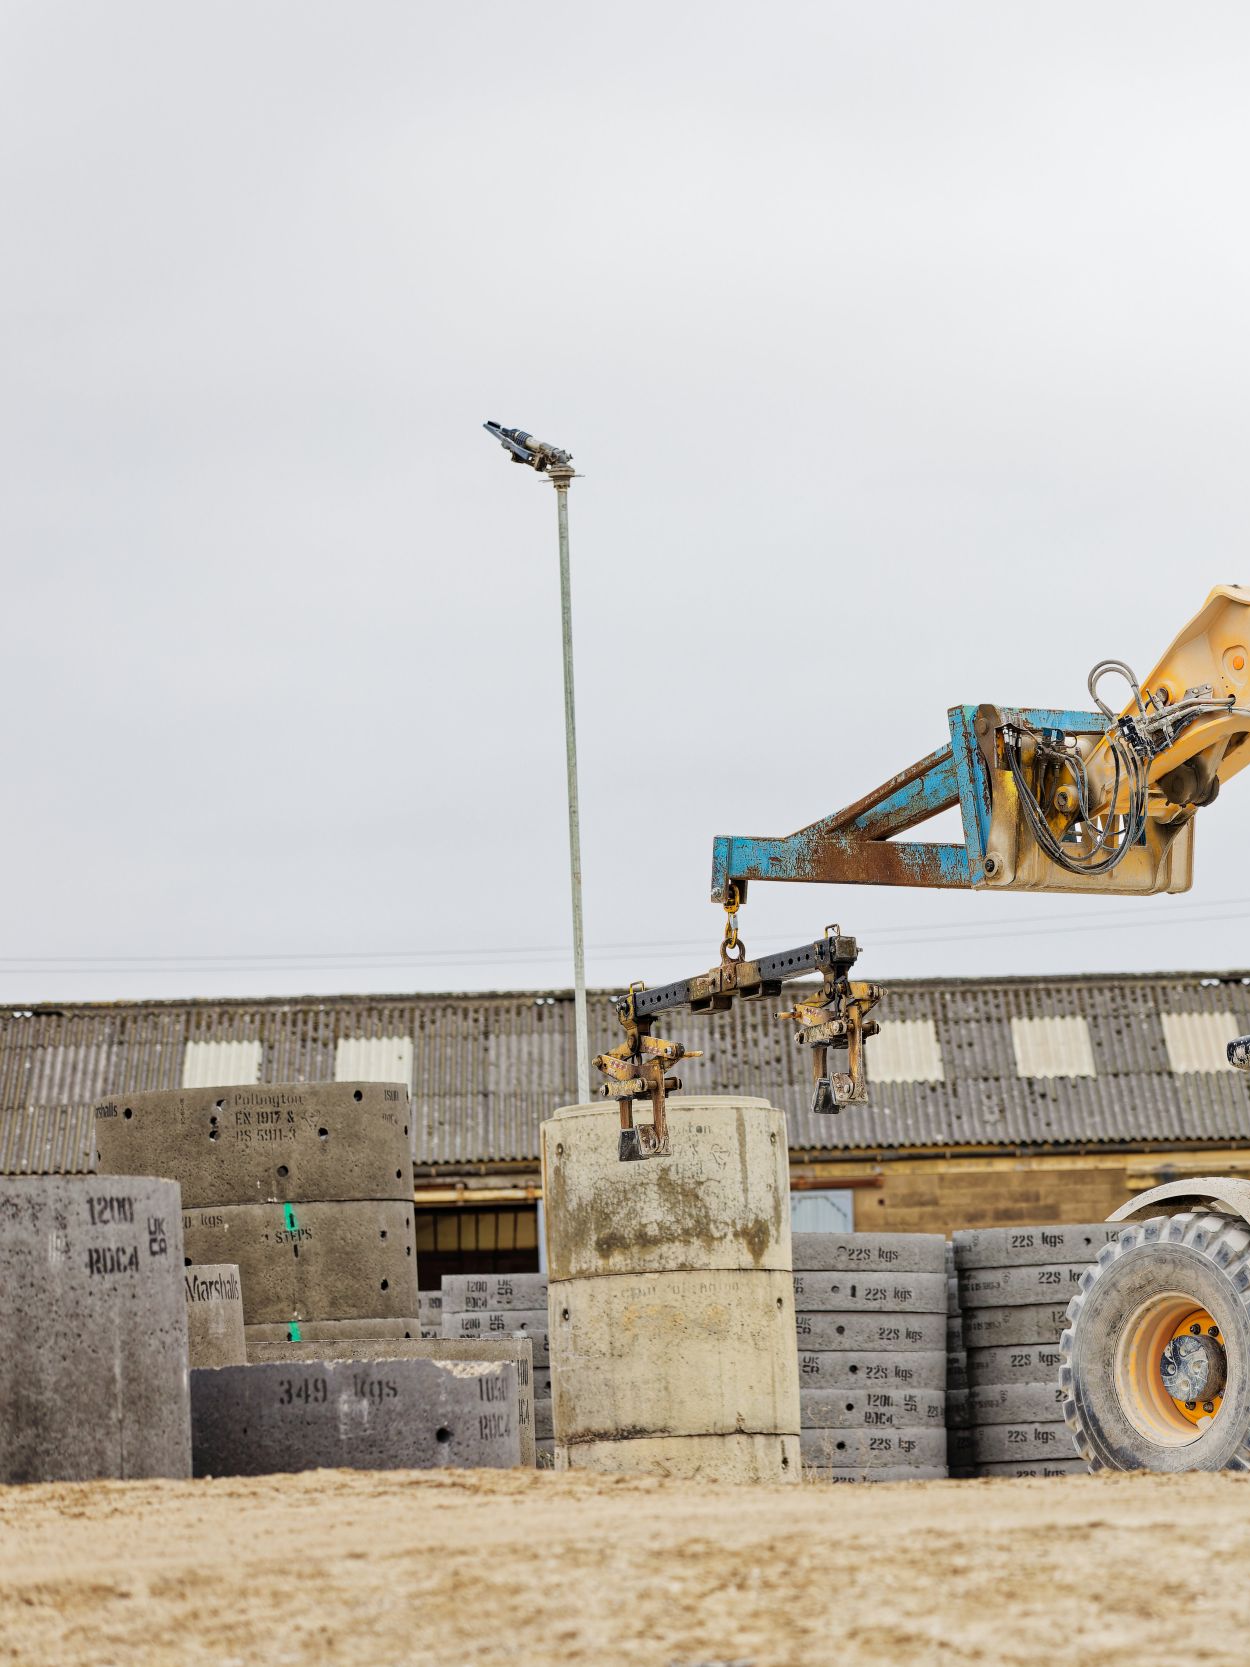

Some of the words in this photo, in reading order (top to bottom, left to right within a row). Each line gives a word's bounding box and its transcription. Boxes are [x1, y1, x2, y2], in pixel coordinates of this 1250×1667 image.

[235, 1110, 252, 1125] EN
[256, 1110, 281, 1125] 1917
[287, 1109, 295, 1124] &
[86, 1195, 135, 1226] 1200
[147, 1215, 166, 1237] UK
[201, 1213, 223, 1228] kgs
[149, 1237, 167, 1257] CA
[1041, 1232, 1064, 1248] kgs
[878, 1247, 899, 1262] kgs
[184, 1272, 240, 1302] Marshalls
[466, 1280, 488, 1292] 1200
[893, 1286, 913, 1302] kgs
[461, 1318, 480, 1330] 1200
[905, 1327, 923, 1343] kgs
[803, 1356, 820, 1365] UK
[1038, 1352, 1061, 1366] kgs
[895, 1365, 913, 1381] kgs
[279, 1377, 328, 1405] 349
[353, 1374, 398, 1405] kgs
[867, 1393, 893, 1407] 1200
[1034, 1428, 1056, 1444] kgs
[898, 1437, 917, 1453] kgs
